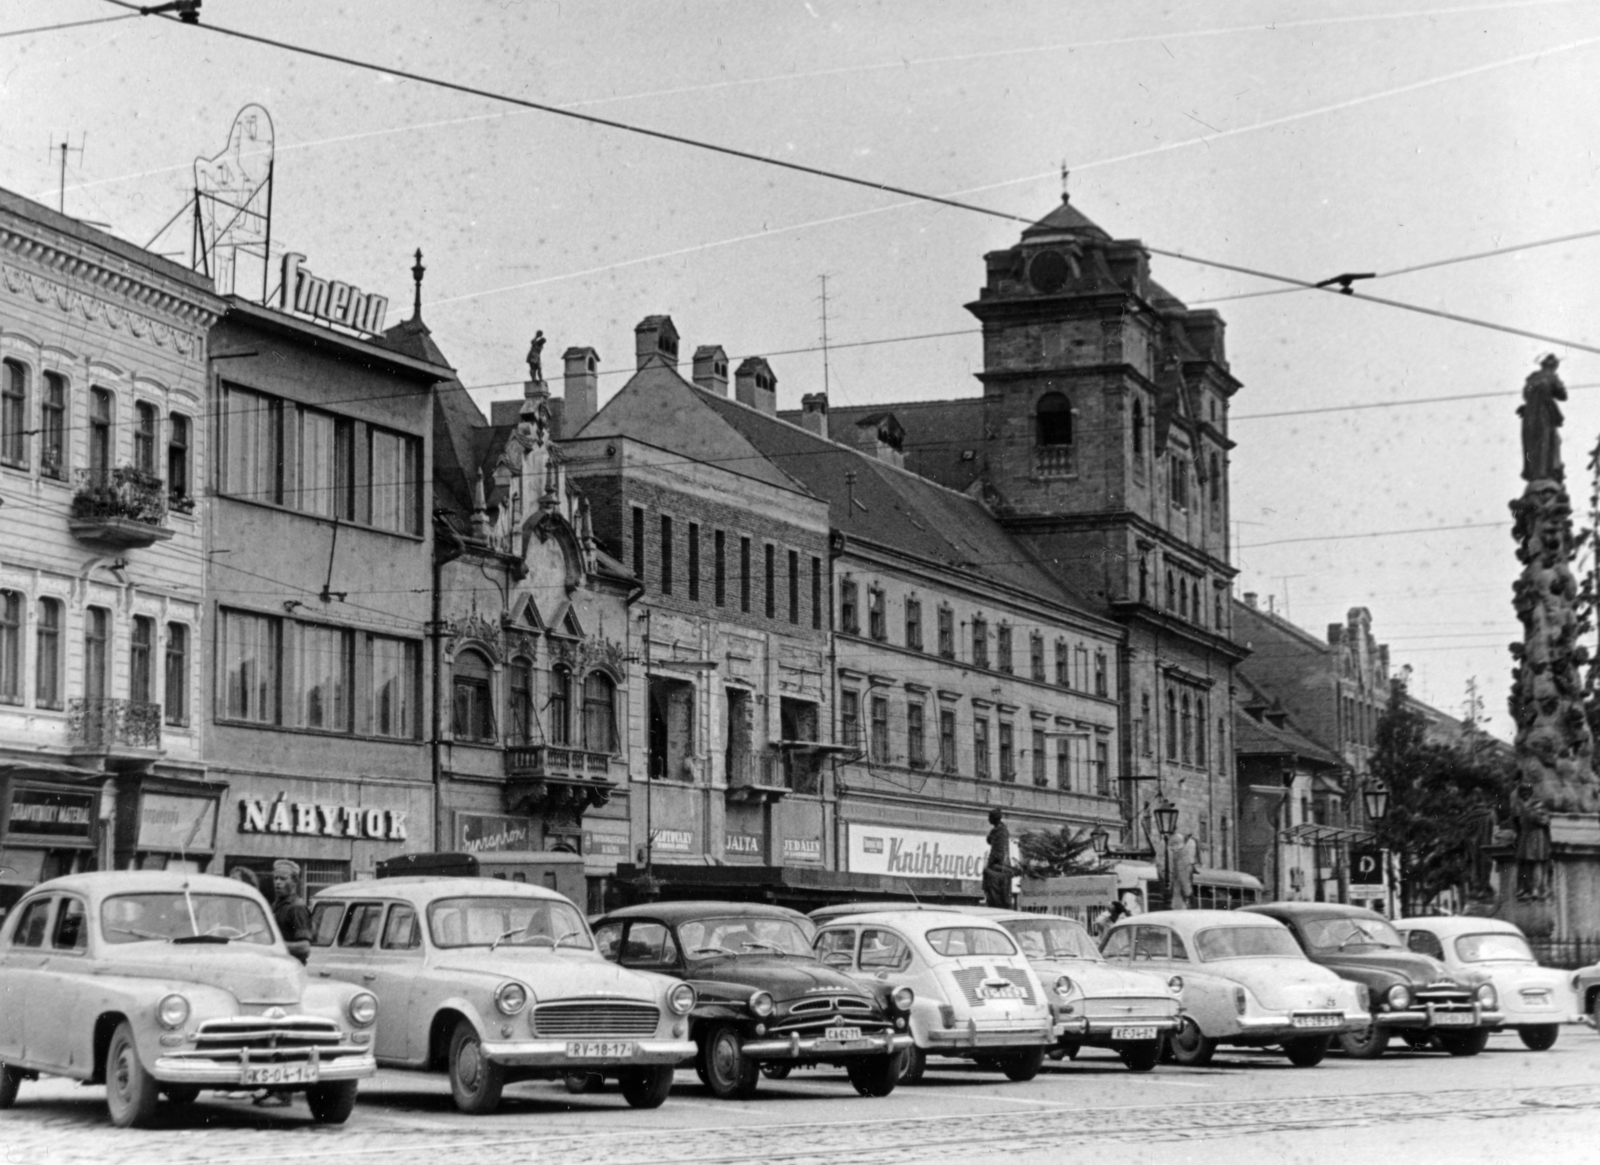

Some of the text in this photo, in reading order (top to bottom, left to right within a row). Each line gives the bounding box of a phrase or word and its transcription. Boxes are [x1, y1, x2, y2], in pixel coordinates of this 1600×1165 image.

[280, 253, 388, 338] Smena
[240, 791, 407, 840] NÁBYTOK
[726, 836, 758, 851] JALTA
[573, 1043, 627, 1056] RV-18-17
